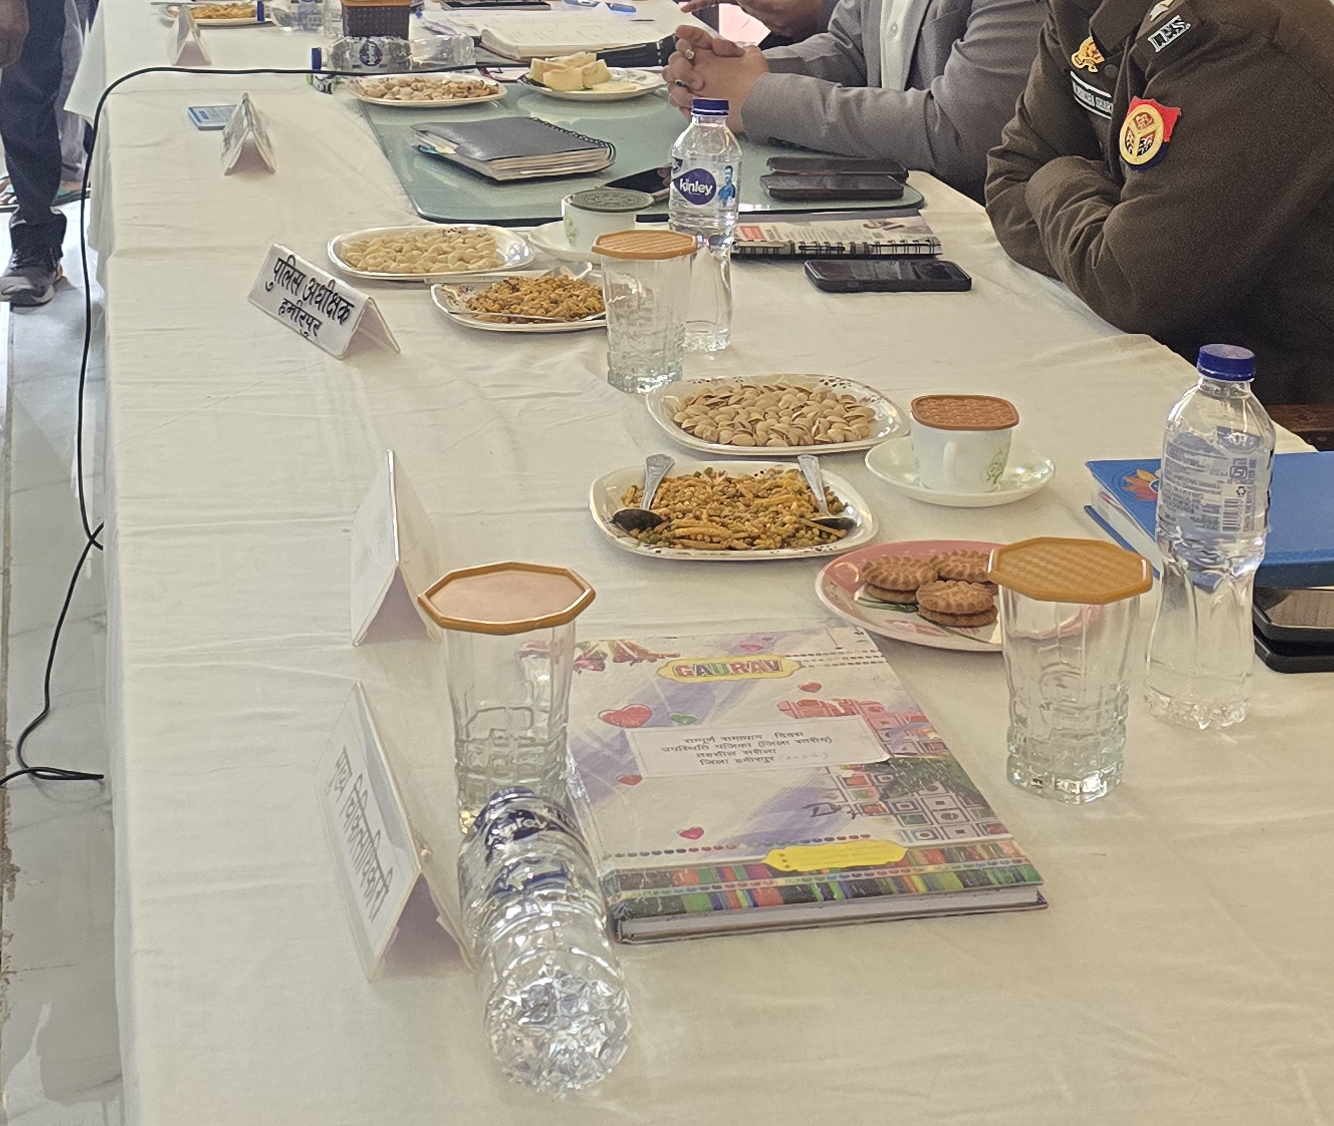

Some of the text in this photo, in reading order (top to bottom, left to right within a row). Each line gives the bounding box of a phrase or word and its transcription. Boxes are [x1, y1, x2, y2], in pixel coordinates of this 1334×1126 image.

[679, 177, 714, 197] kinley
[265, 254, 355, 325] पुलिस अधीक्षक
[278, 298, 323, 338] हमीरपुर
[672, 660, 784, 678] GAURAV
[325, 745, 353, 805] मुख्य
